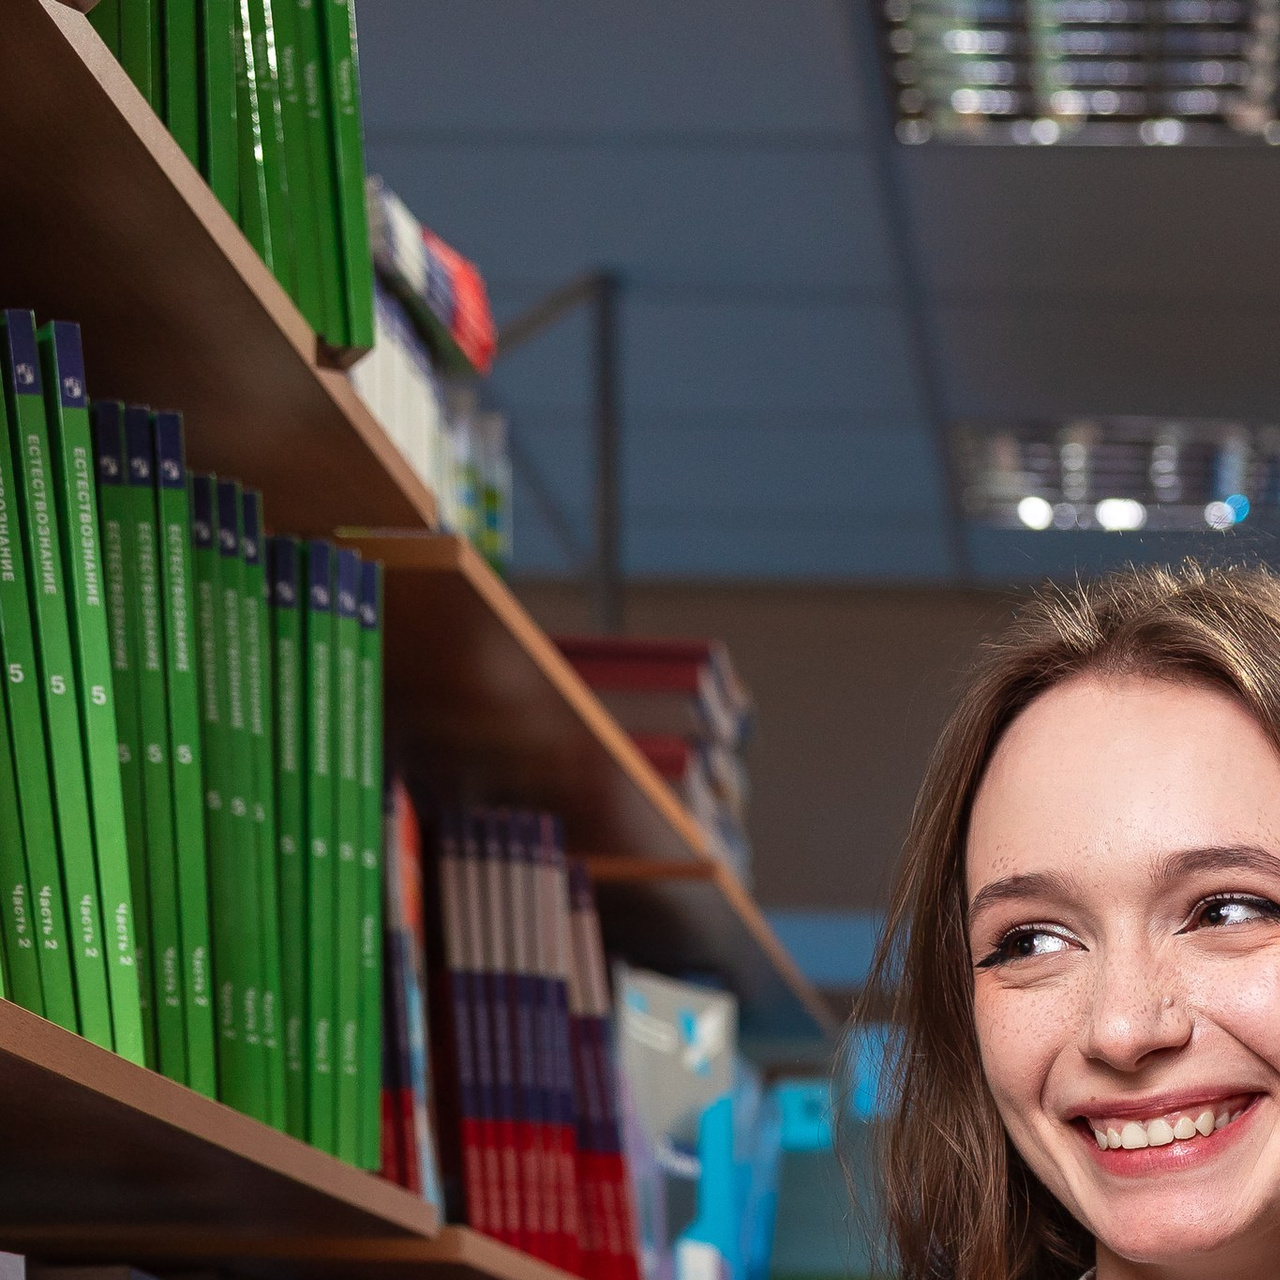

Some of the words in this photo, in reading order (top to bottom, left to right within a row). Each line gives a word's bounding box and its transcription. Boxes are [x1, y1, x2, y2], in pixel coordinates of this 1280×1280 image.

[27, 434, 57, 595] ЕСТЕСТВОЗНАНИЕ
[73, 446, 99, 606] ЕСТЕСТВОЗНАНИЕ
[9, 664, 24, 683] 5
[51, 675, 66, 695] 5
[91, 685, 106, 705] 5
[13, 884, 27, 934] Часть
[39, 885, 54, 935] Часть
[80, 894, 94, 943] Часть
[115, 902, 128, 951] Часть
[18, 937, 31, 949] 2
[44, 938, 58, 950] 2
[85, 947, 98, 958] 2
[119, 955, 133, 966] 2
